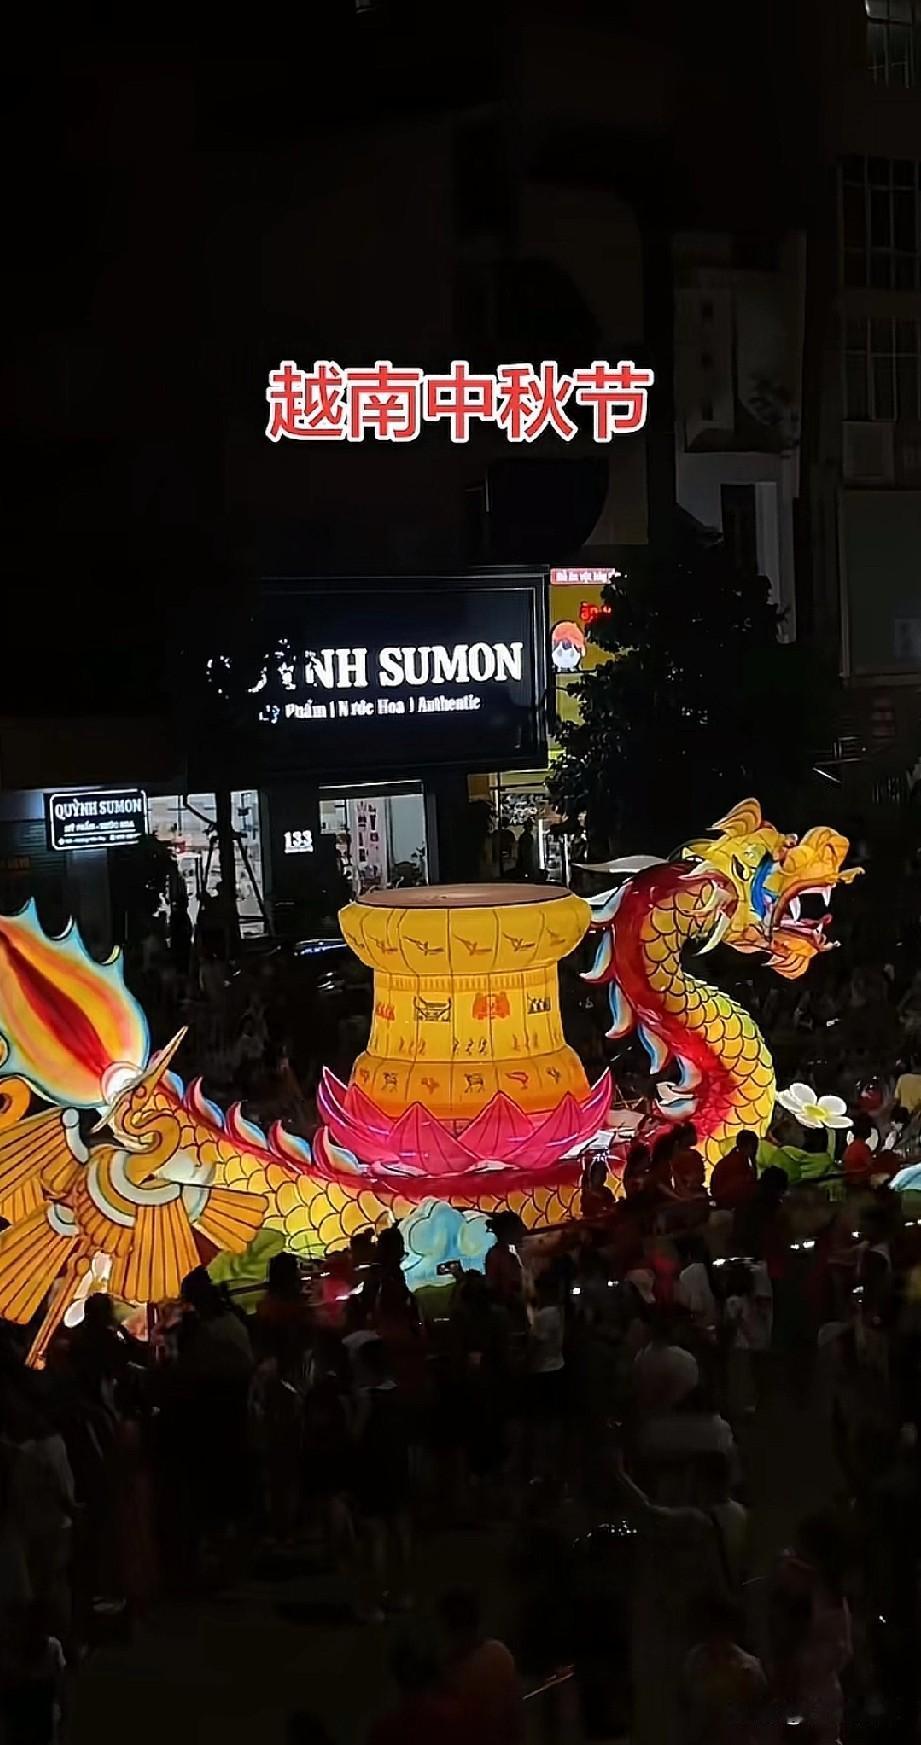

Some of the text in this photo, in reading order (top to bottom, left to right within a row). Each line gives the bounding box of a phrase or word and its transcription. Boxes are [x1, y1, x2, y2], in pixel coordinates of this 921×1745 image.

[379, 641, 523, 687] SUMON
[378, 699, 405, 715] Hoa
[418, 694, 481, 713] Authentic
[54, 798, 142, 820] QUỲNH SUMON
[284, 830, 313, 848] 133
